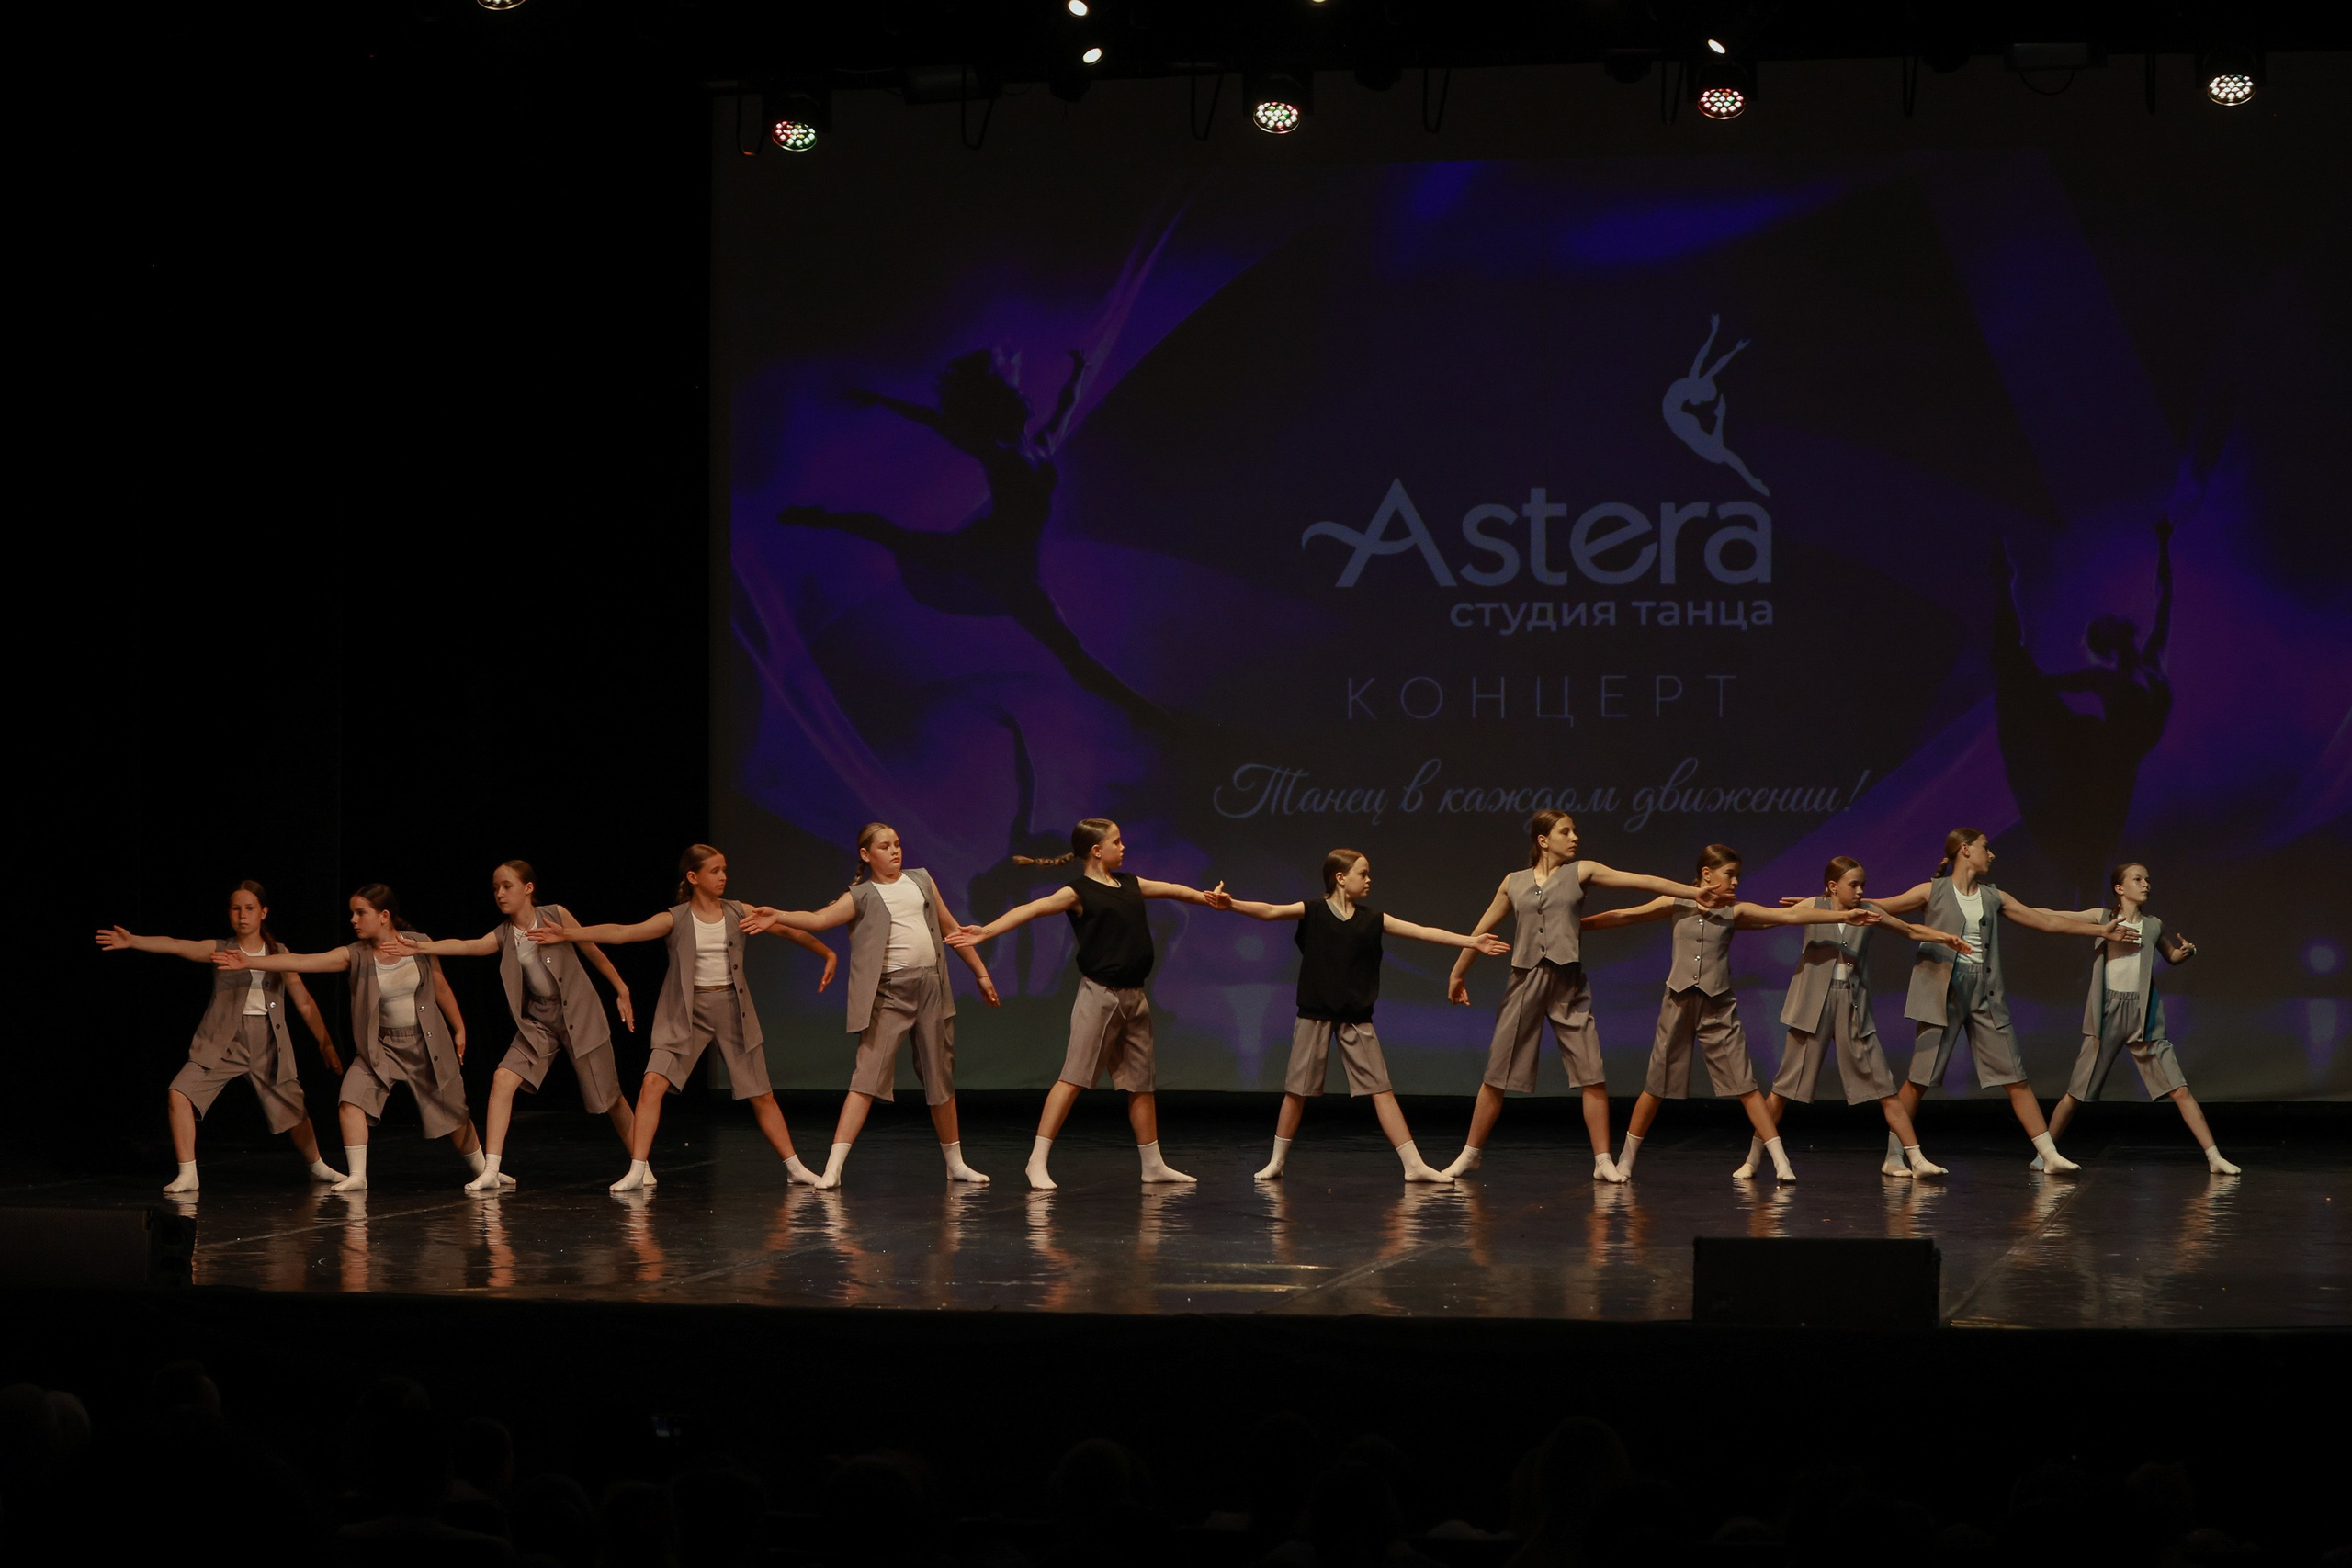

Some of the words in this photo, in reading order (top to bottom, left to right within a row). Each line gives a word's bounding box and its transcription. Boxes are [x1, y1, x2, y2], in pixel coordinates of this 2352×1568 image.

[1301, 477, 1773, 588] Astera
[1449, 600, 1618, 637] студия
[1630, 598, 1775, 631] танца
[1346, 675, 1737, 728] КОНЦЕРТ
[1212, 762, 1389, 826] Танец
[1397, 758, 1442, 814] в
[1437, 786, 1622, 833] каждом
[1623, 756, 1871, 834] движении!
